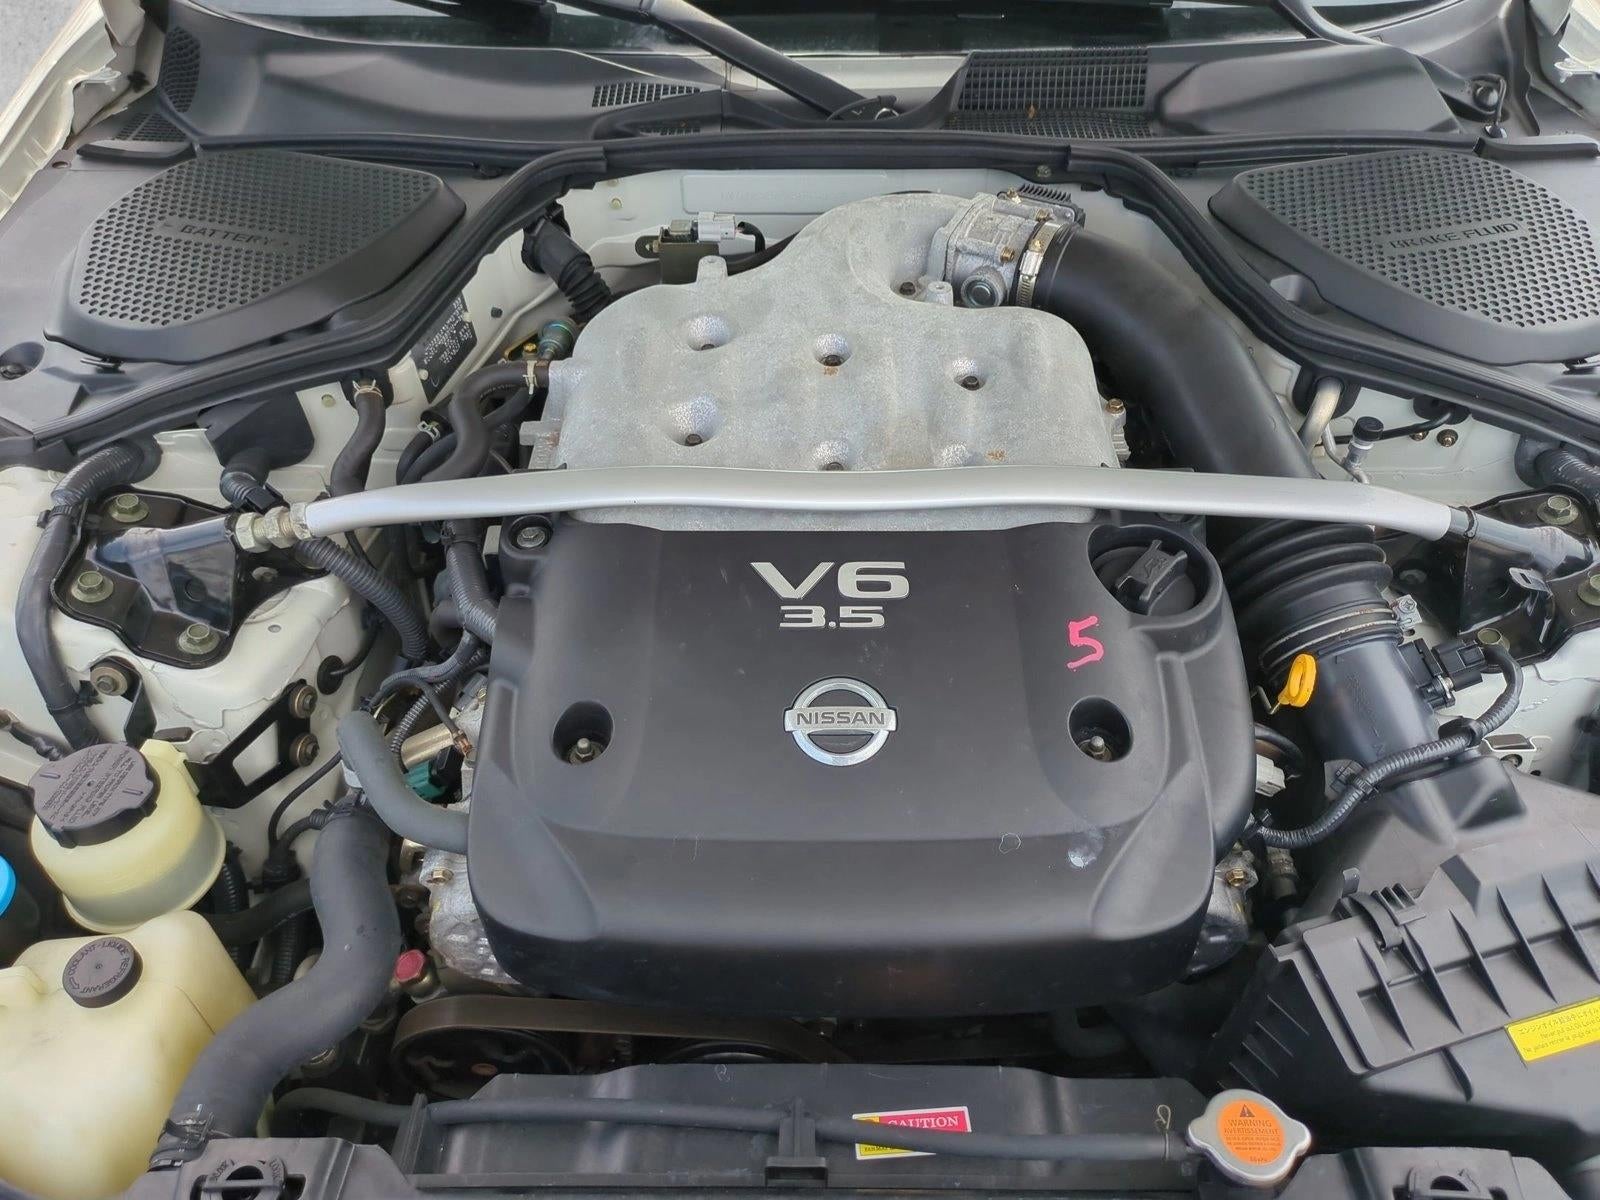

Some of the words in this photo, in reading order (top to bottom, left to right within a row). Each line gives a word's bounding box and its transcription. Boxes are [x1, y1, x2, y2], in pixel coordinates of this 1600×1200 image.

[180, 224, 275, 246] BATTERY
[1389, 233, 1460, 249] BRAKE
[1463, 223, 1519, 239] FLUID
[750, 562, 910, 599] V6
[779, 605, 885, 628] 3.5
[1067, 615, 1104, 669] 5
[796, 711, 886, 725] NISSAN
[1228, 1119, 1272, 1128] WARNING
